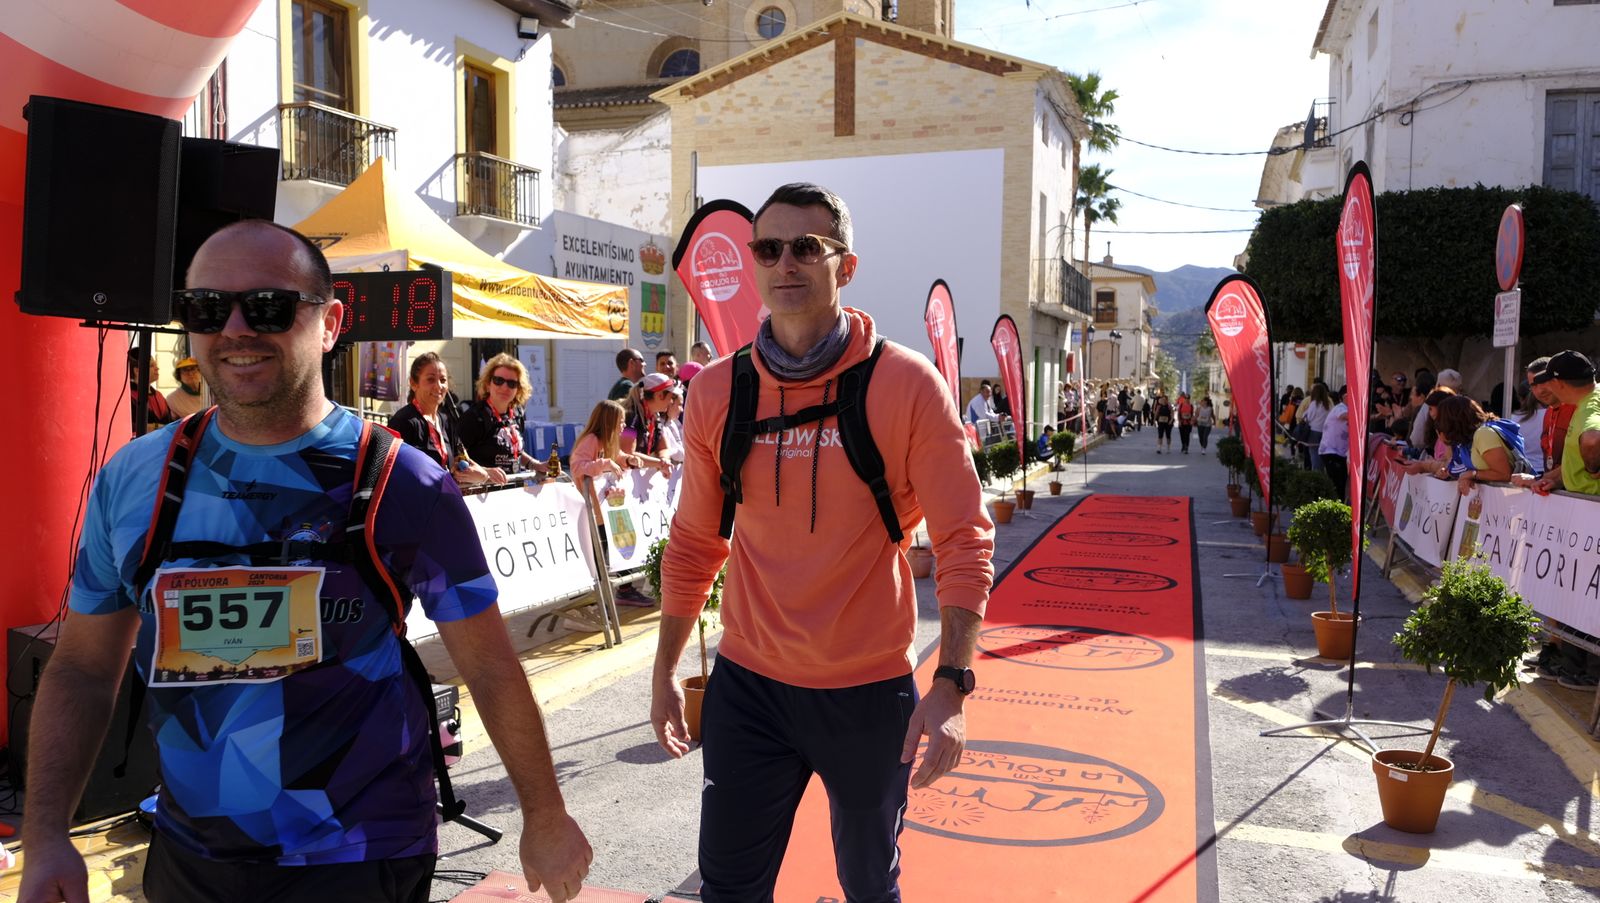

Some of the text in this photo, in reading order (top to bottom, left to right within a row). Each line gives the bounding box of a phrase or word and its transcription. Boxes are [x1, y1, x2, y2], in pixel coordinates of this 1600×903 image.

[563, 235, 634, 263] EXCELENTÍSIMO
[565, 261, 634, 286] AYUNTAMIENTO
[753, 428, 845, 448] LLOW SK
[776, 447, 813, 459] original
[483, 510, 568, 540] IENTO DE
[1486, 513, 1578, 548] AYNTAMIENO
[495, 532, 579, 578] ORIA
[171, 579, 183, 589] LA
[183, 591, 284, 631] 557
[320, 597, 365, 625] DOS
[968, 694, 1133, 716] Ayuntamient
[964, 751, 1007, 761] Cant
[1081, 770, 1124, 784] LA
